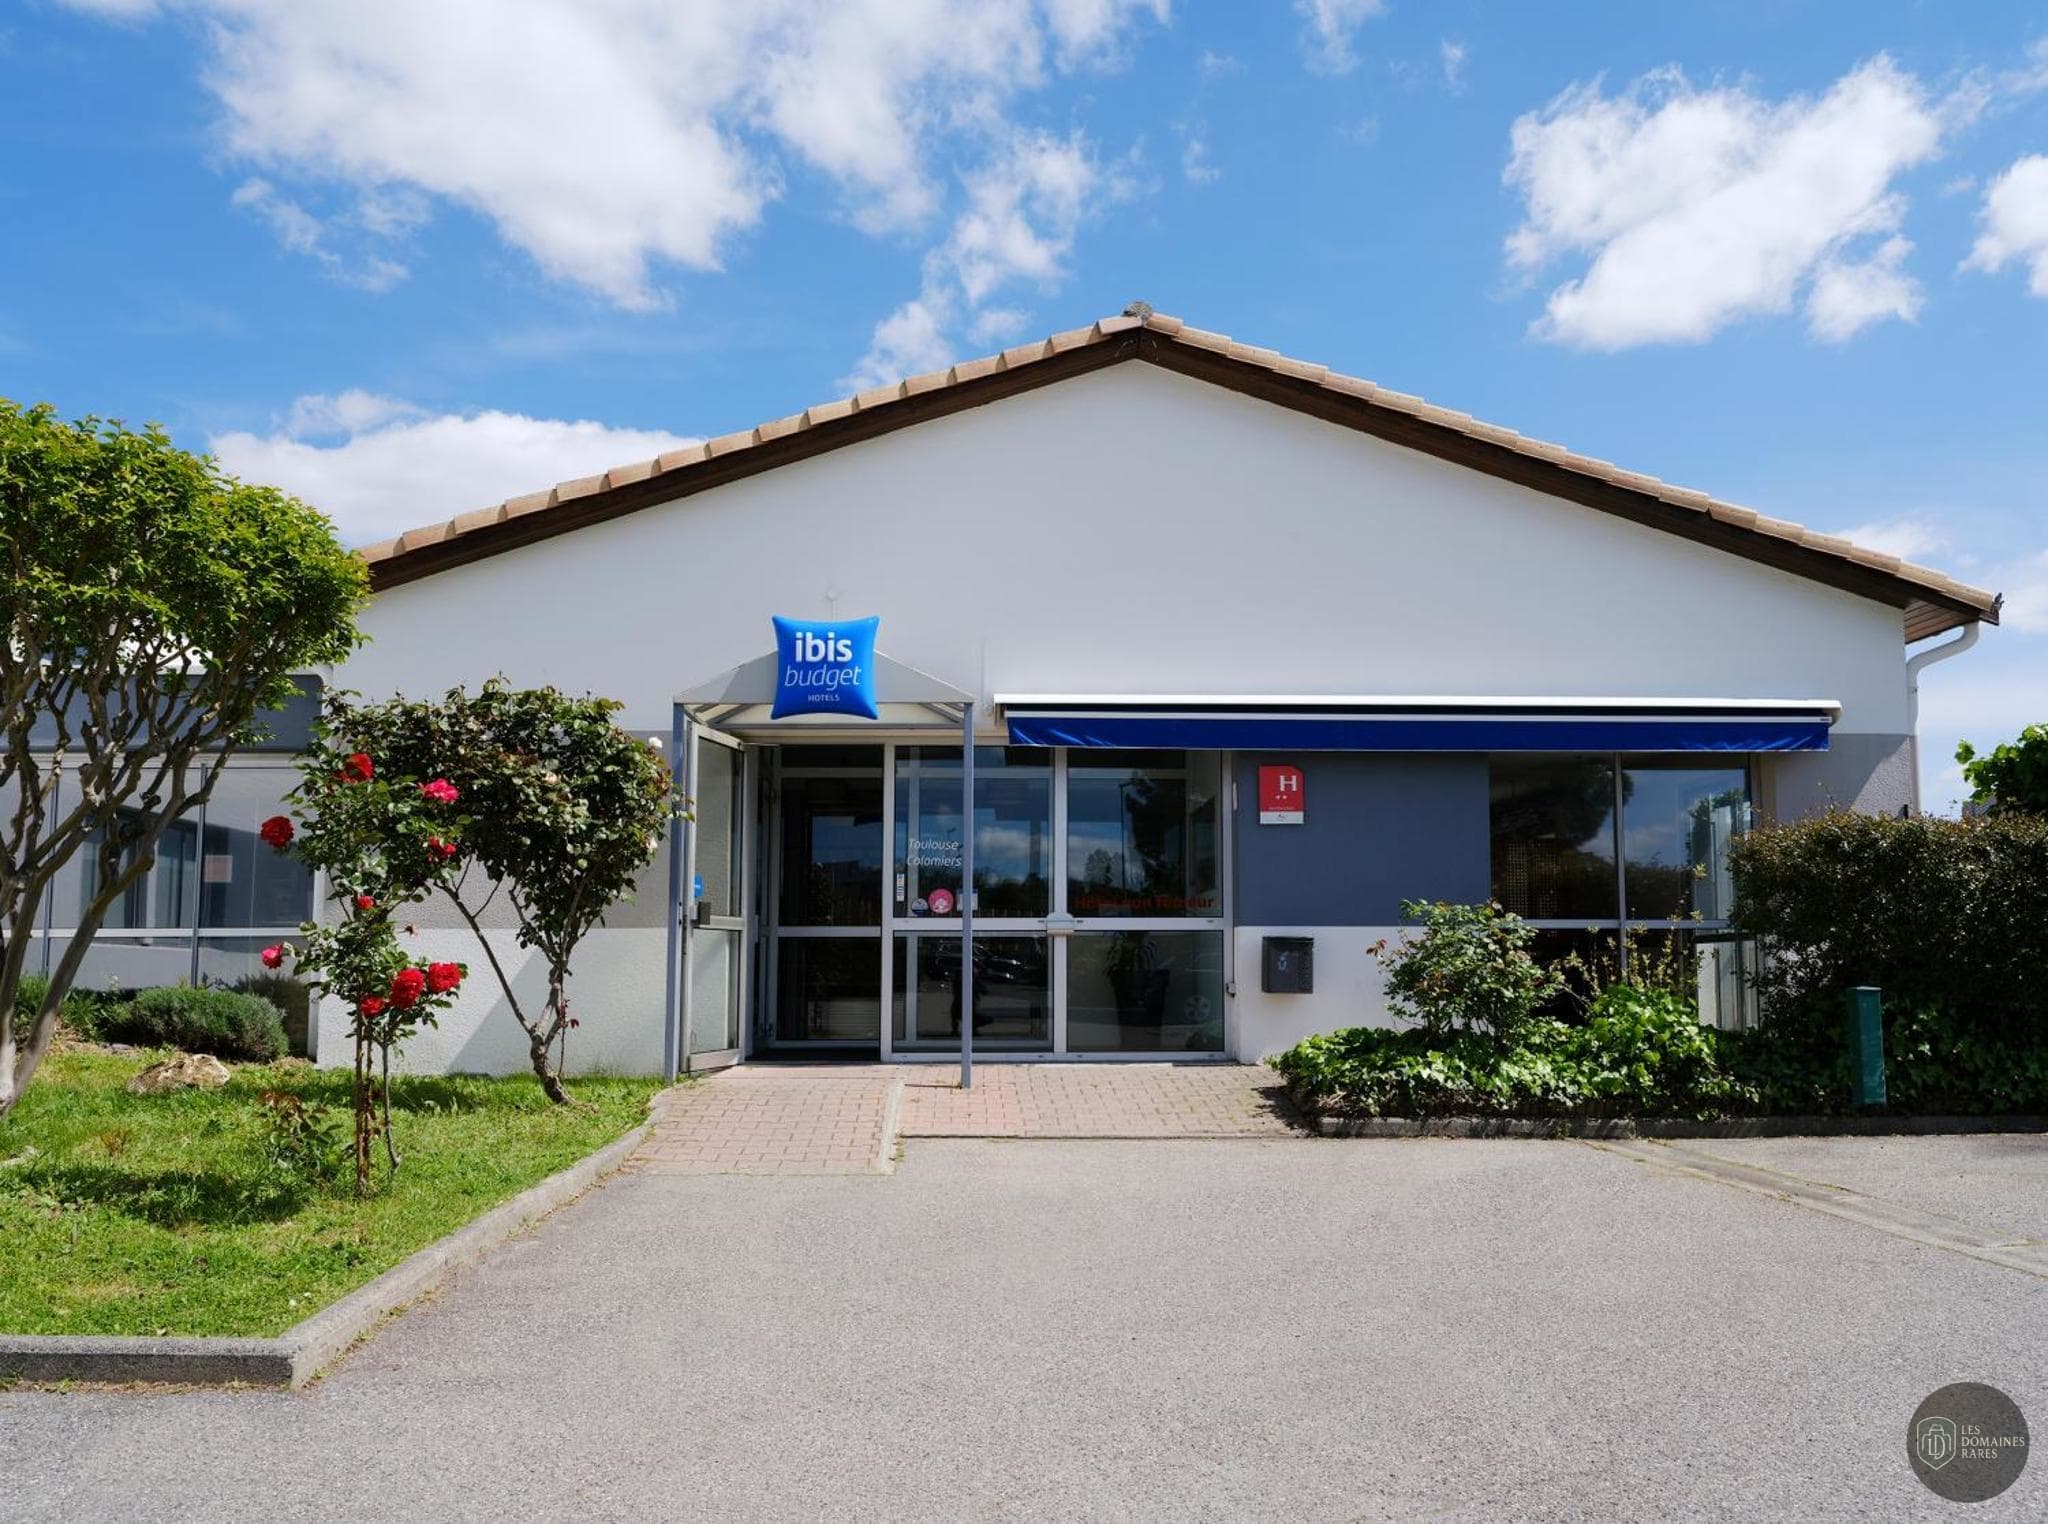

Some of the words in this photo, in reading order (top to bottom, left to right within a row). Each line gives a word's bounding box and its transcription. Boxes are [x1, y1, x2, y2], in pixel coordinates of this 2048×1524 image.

[795, 631, 853, 662] ibis
[784, 664, 862, 691] budget
[808, 694, 841, 702] HOTELS
[1280, 775, 1297, 791] H
[908, 838, 960, 850] Toulouse
[907, 854, 962, 867] Colomiers
